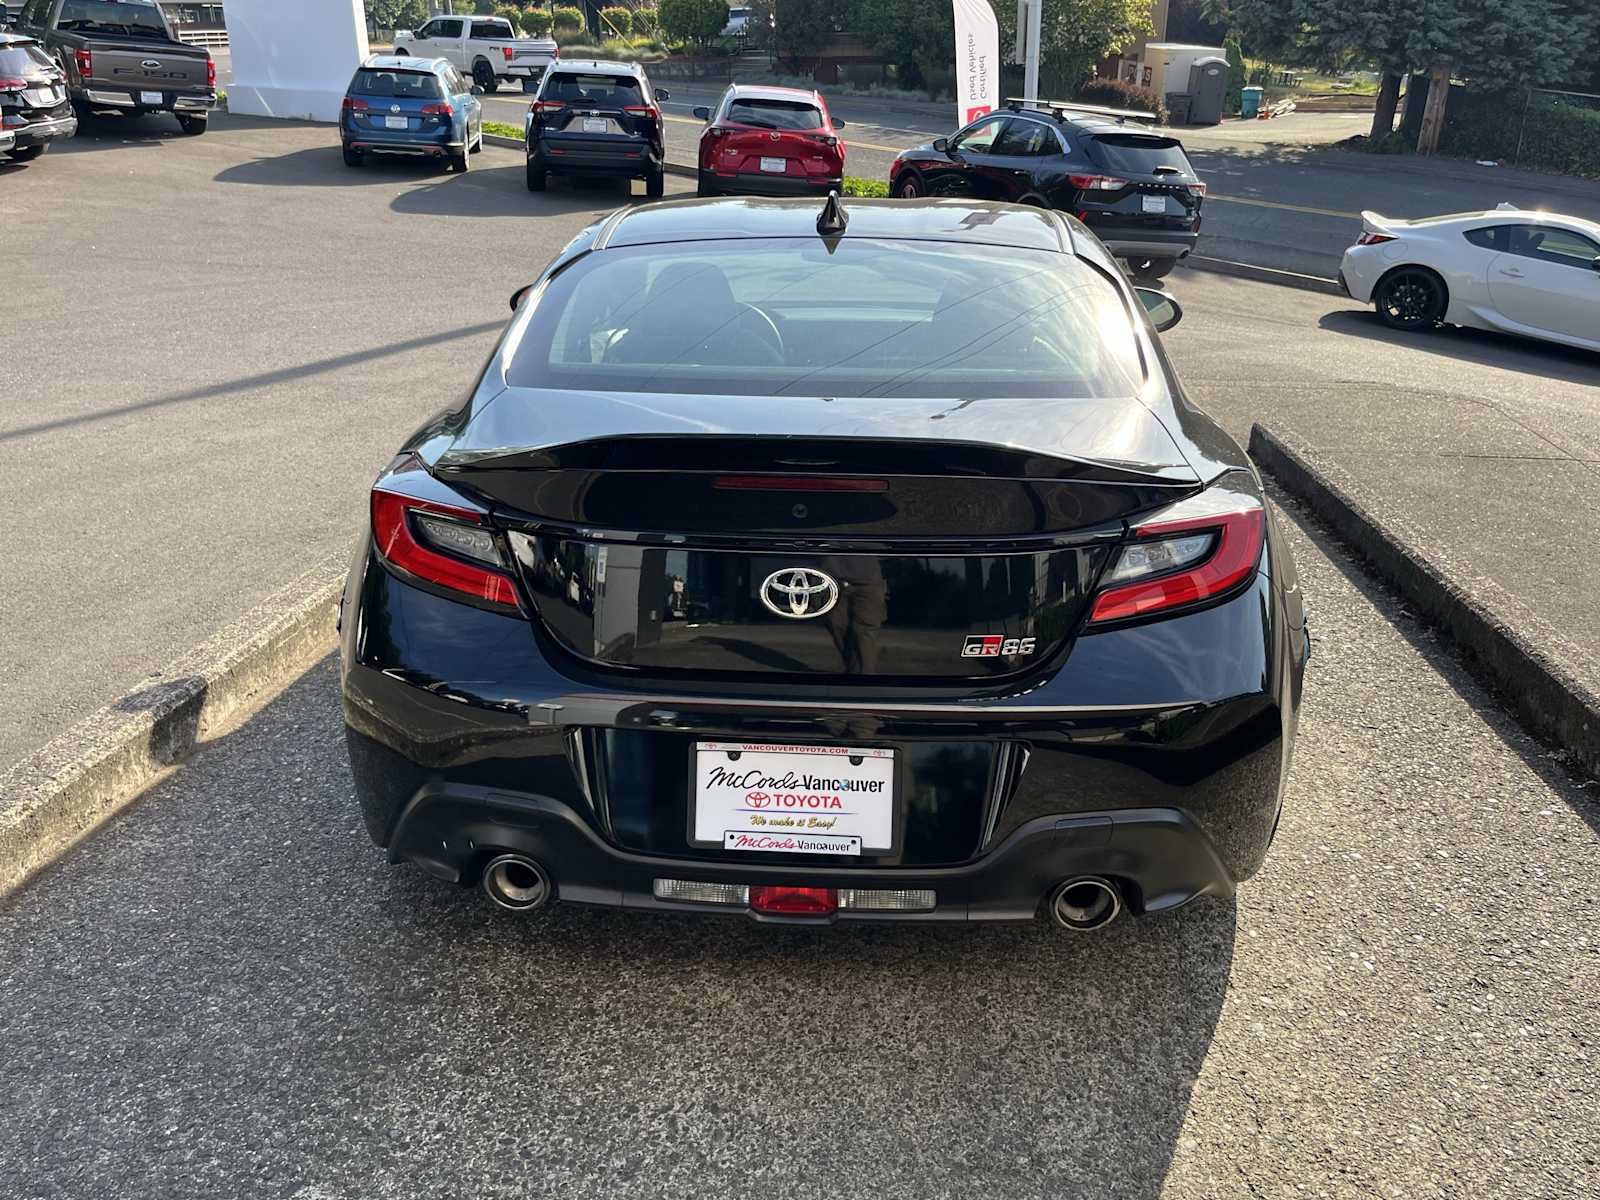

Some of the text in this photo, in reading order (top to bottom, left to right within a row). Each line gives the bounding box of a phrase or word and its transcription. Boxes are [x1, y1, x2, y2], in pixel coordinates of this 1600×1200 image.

[742, 744, 849, 754] VANCOUVERTOYOTA.COM
[706, 766, 885, 793] McCords Vancouver
[773, 793, 842, 809] TOYOTA
[750, 815, 766, 826] We
[769, 817, 795, 827] make
[735, 835, 851, 852] McCords Vancouver
